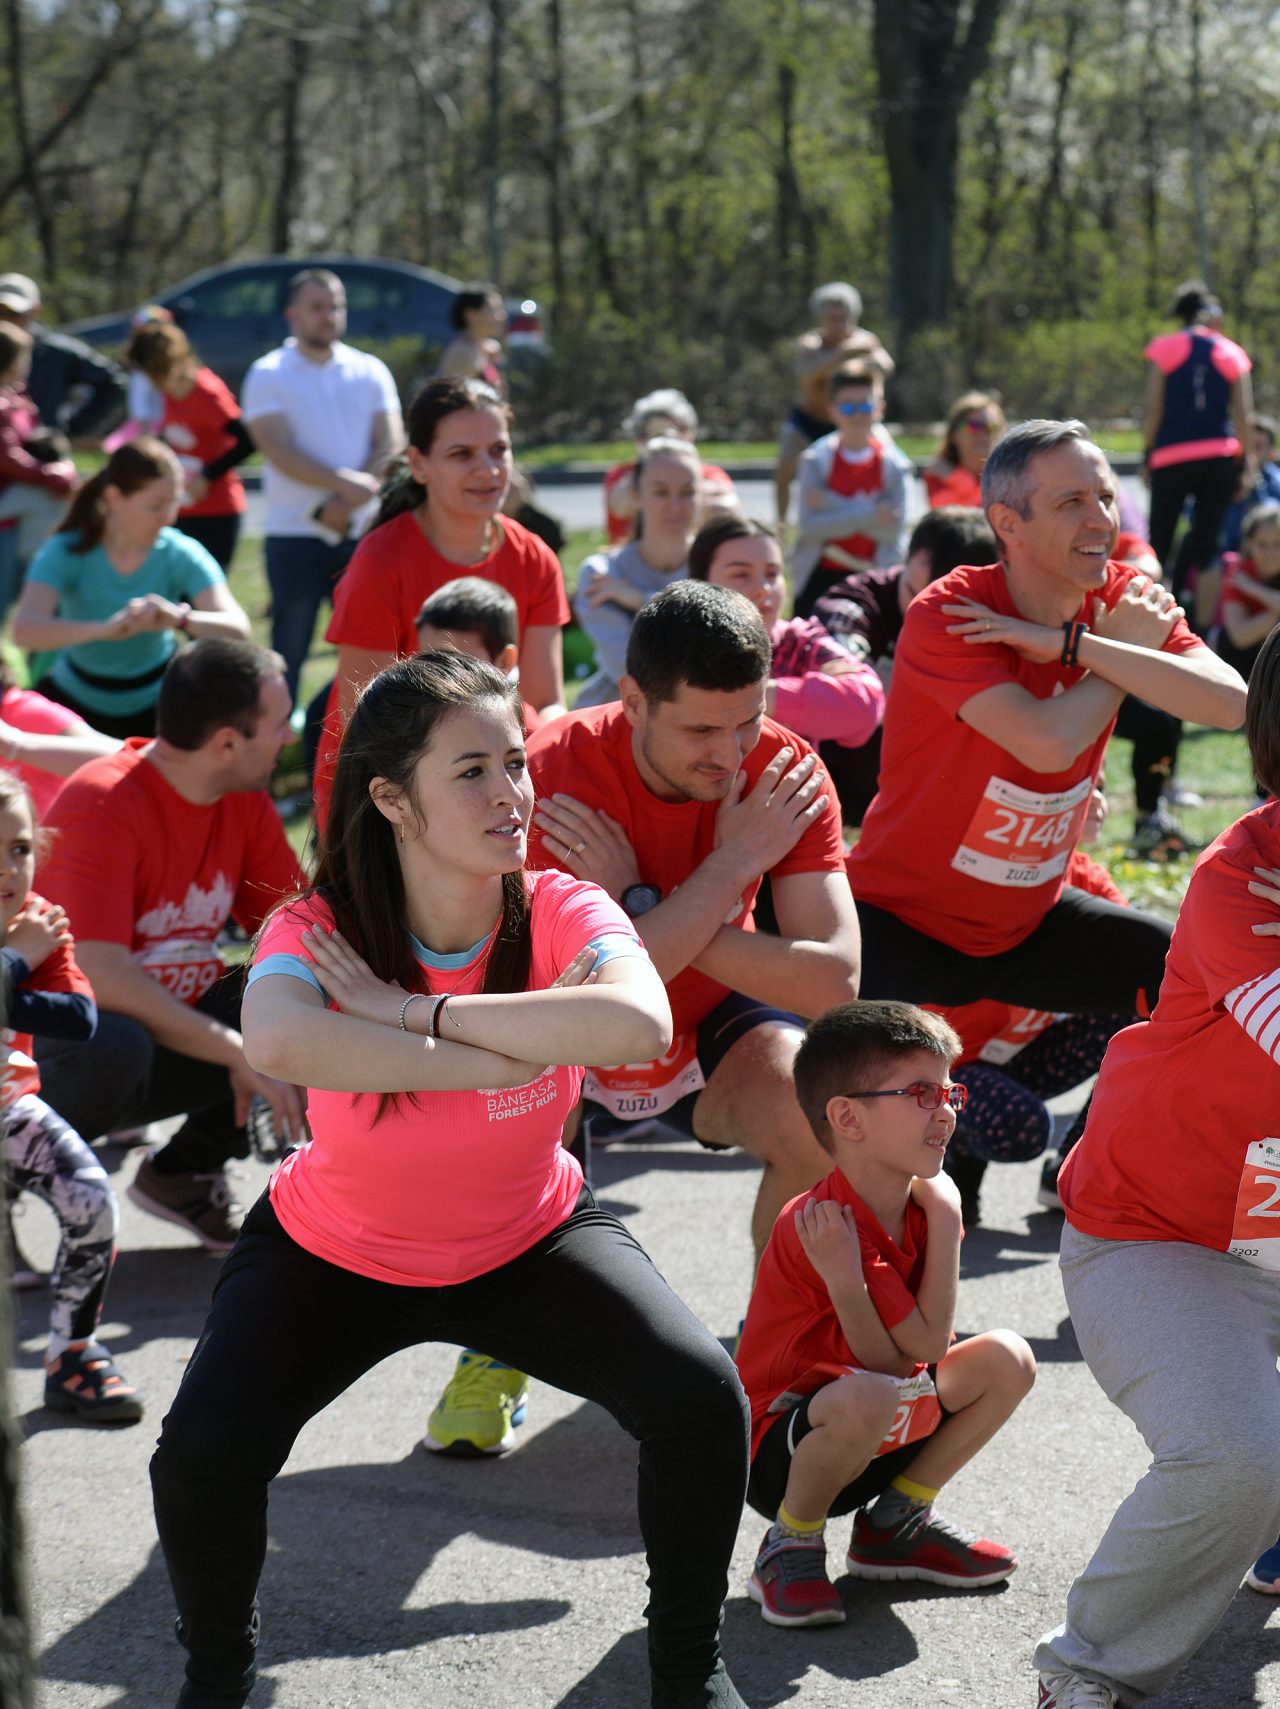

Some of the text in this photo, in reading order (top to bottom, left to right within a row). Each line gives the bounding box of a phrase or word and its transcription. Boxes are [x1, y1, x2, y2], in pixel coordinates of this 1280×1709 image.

[984, 808, 1074, 848] 2148
[1006, 868, 1041, 881] ZUZU
[488, 1090, 558, 1122] FOREST RUN
[616, 1097, 658, 1113] ZUZU
